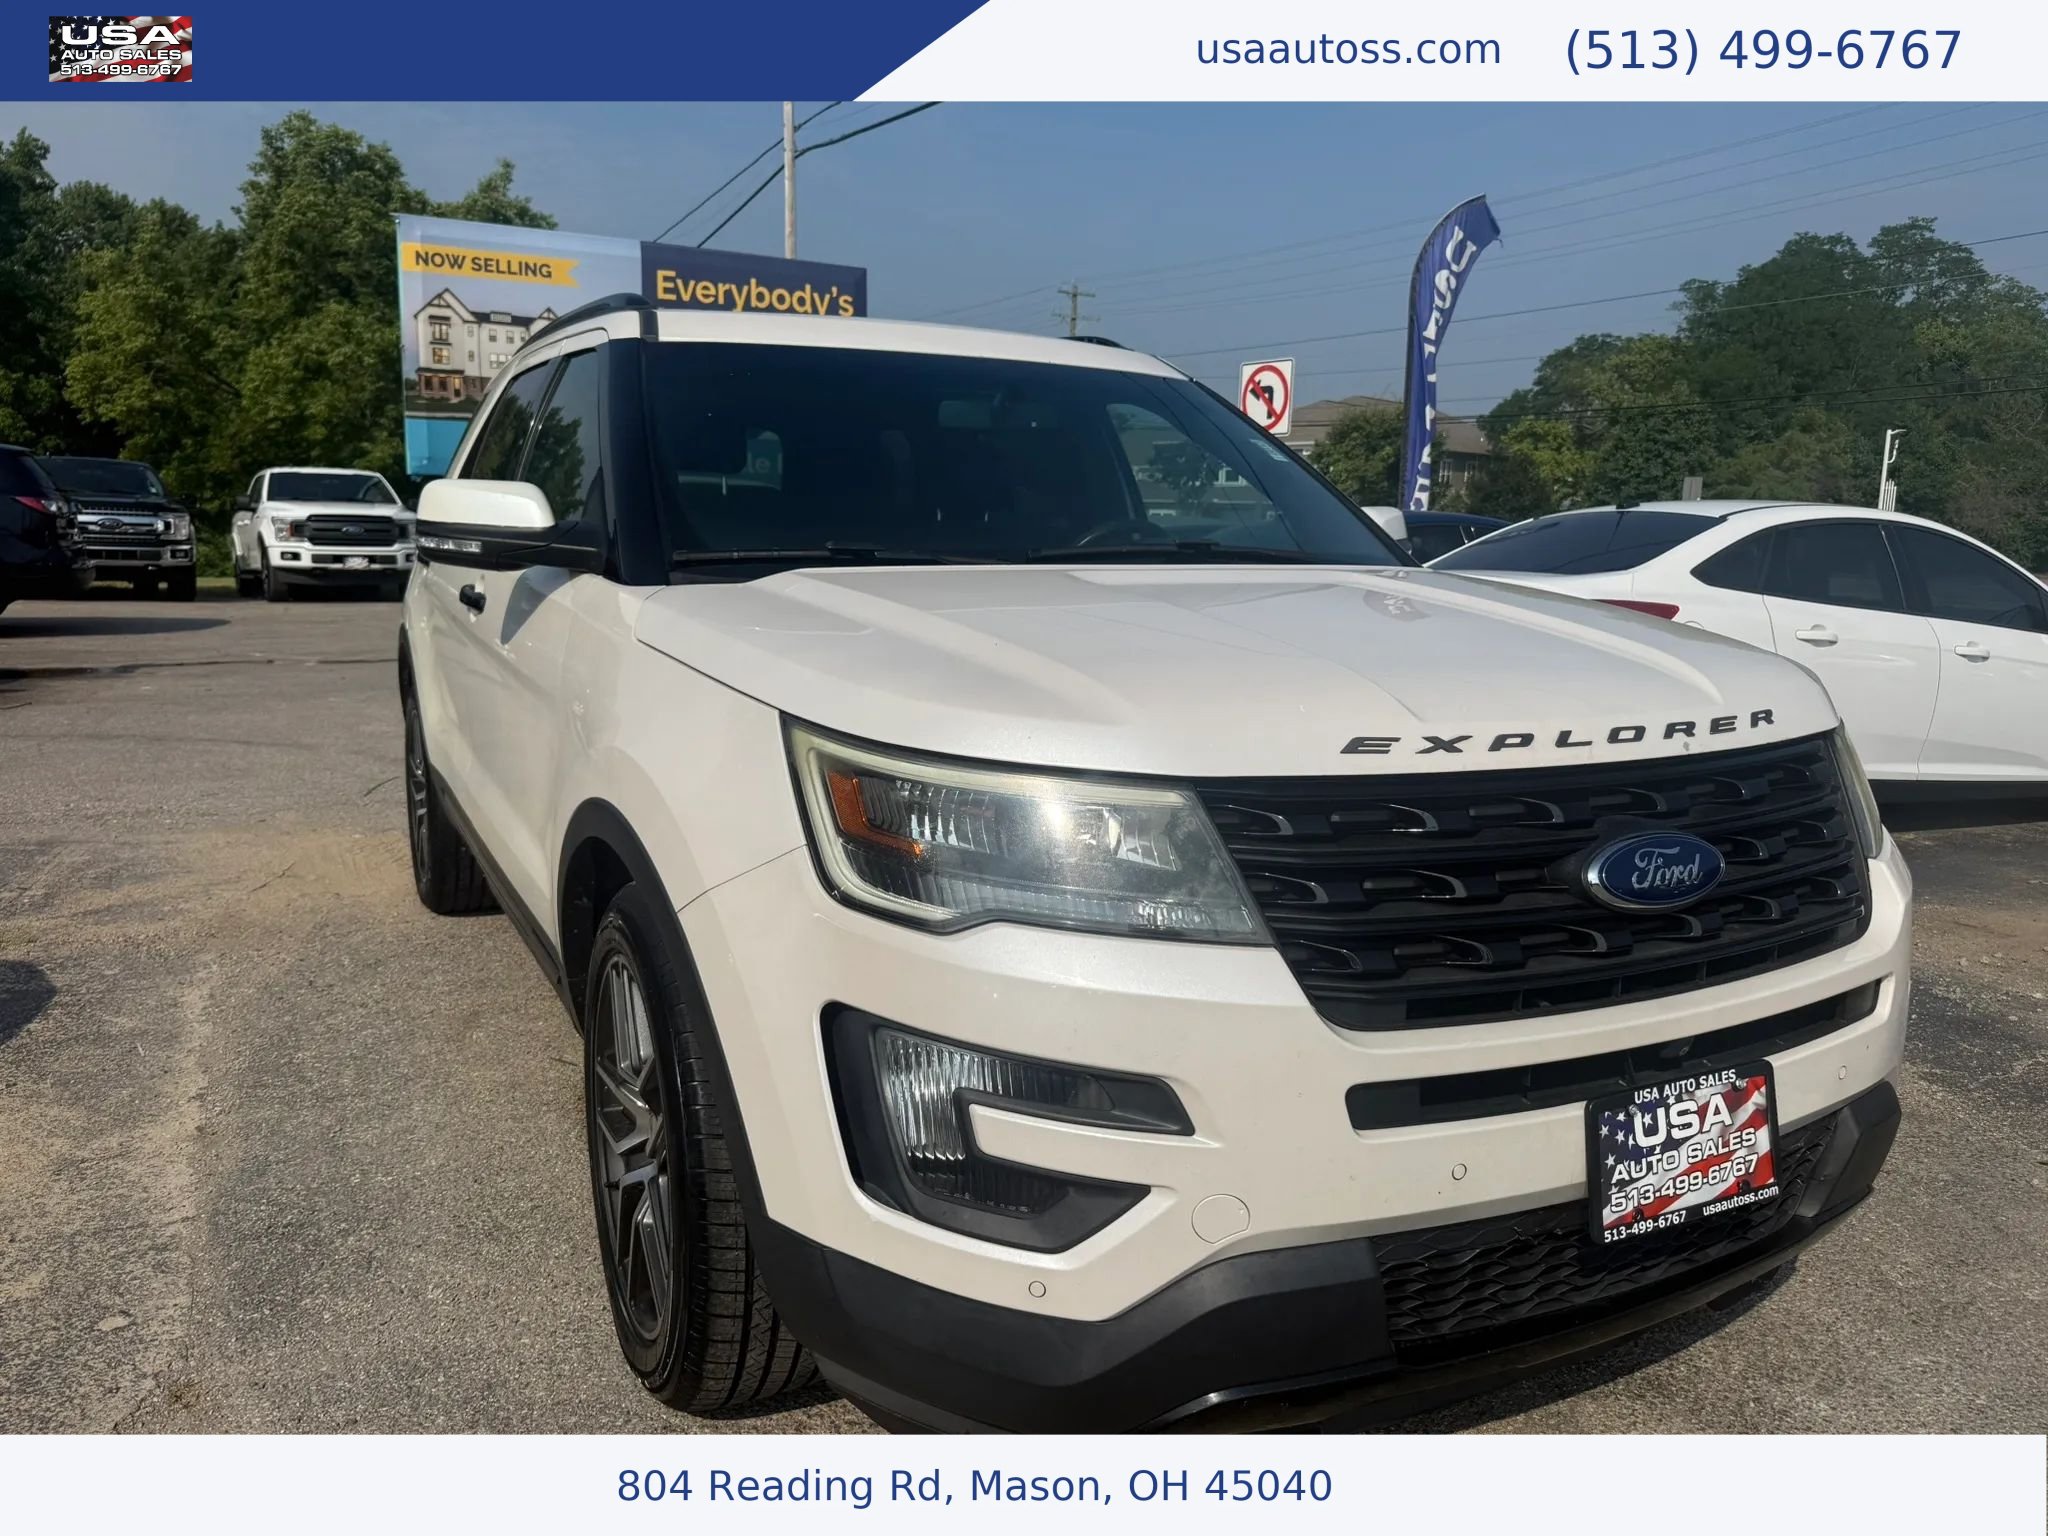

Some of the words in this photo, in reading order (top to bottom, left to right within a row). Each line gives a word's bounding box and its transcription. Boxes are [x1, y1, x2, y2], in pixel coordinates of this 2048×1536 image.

[415, 250, 466, 270] NOW
[471, 256, 553, 279] SELLING
[656, 269, 855, 317] Everybody's
[1339, 708, 1776, 755] EXPLORER
[1631, 846, 1704, 889] Ford
[1634, 1089, 1660, 1105] USA
[1663, 1080, 1697, 1100] AUTO
[1699, 1069, 1738, 1090] SALES
[1633, 1093, 1733, 1149] USA
[1610, 1152, 1681, 1184] AUTO
[1686, 1127, 1758, 1164] SALES
[1609, 1154, 1759, 1214] 513-499-6767
[1604, 1210, 1688, 1244] 513-499-6767
[1702, 1184, 1780, 1217] usaautoss.com
